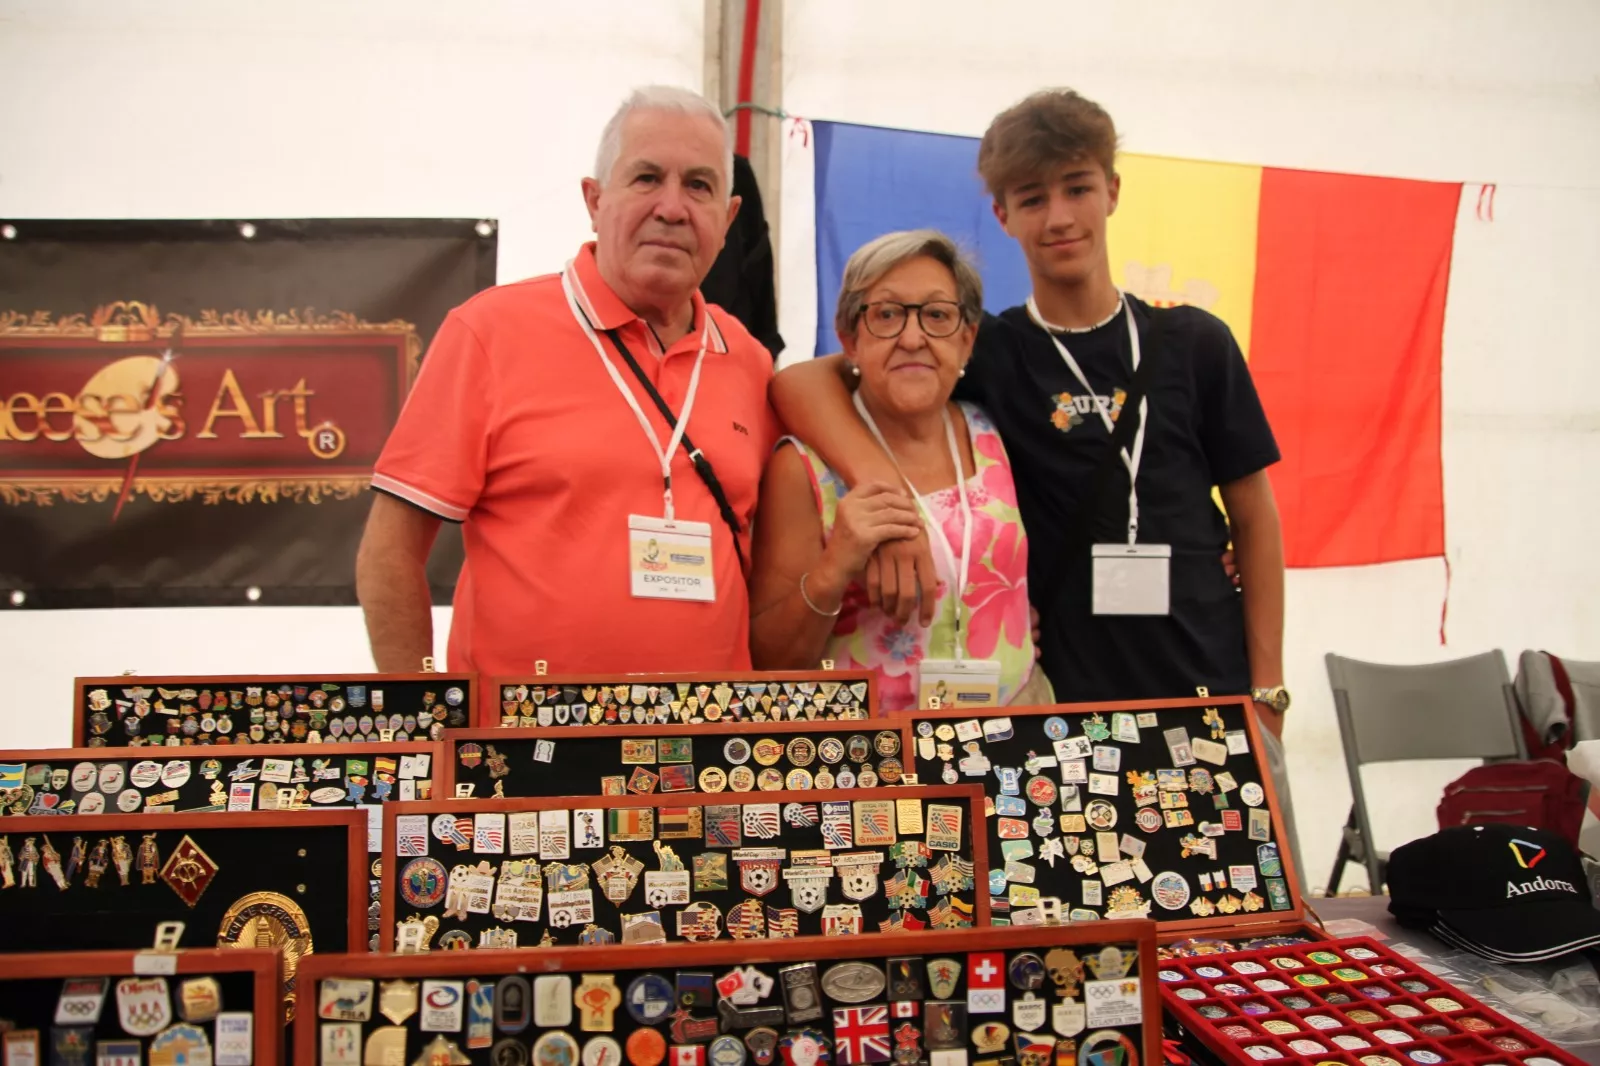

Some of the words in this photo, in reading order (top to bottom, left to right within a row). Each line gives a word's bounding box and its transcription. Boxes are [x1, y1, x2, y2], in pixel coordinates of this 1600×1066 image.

[196, 368, 315, 438] Art
[643, 574, 701, 586] EXPOSITOR
[833, 804, 849, 812] sun
[928, 840, 958, 849] CASIO
[1506, 875, 1578, 899] Andorra
[340, 1010, 366, 1019] FILA
